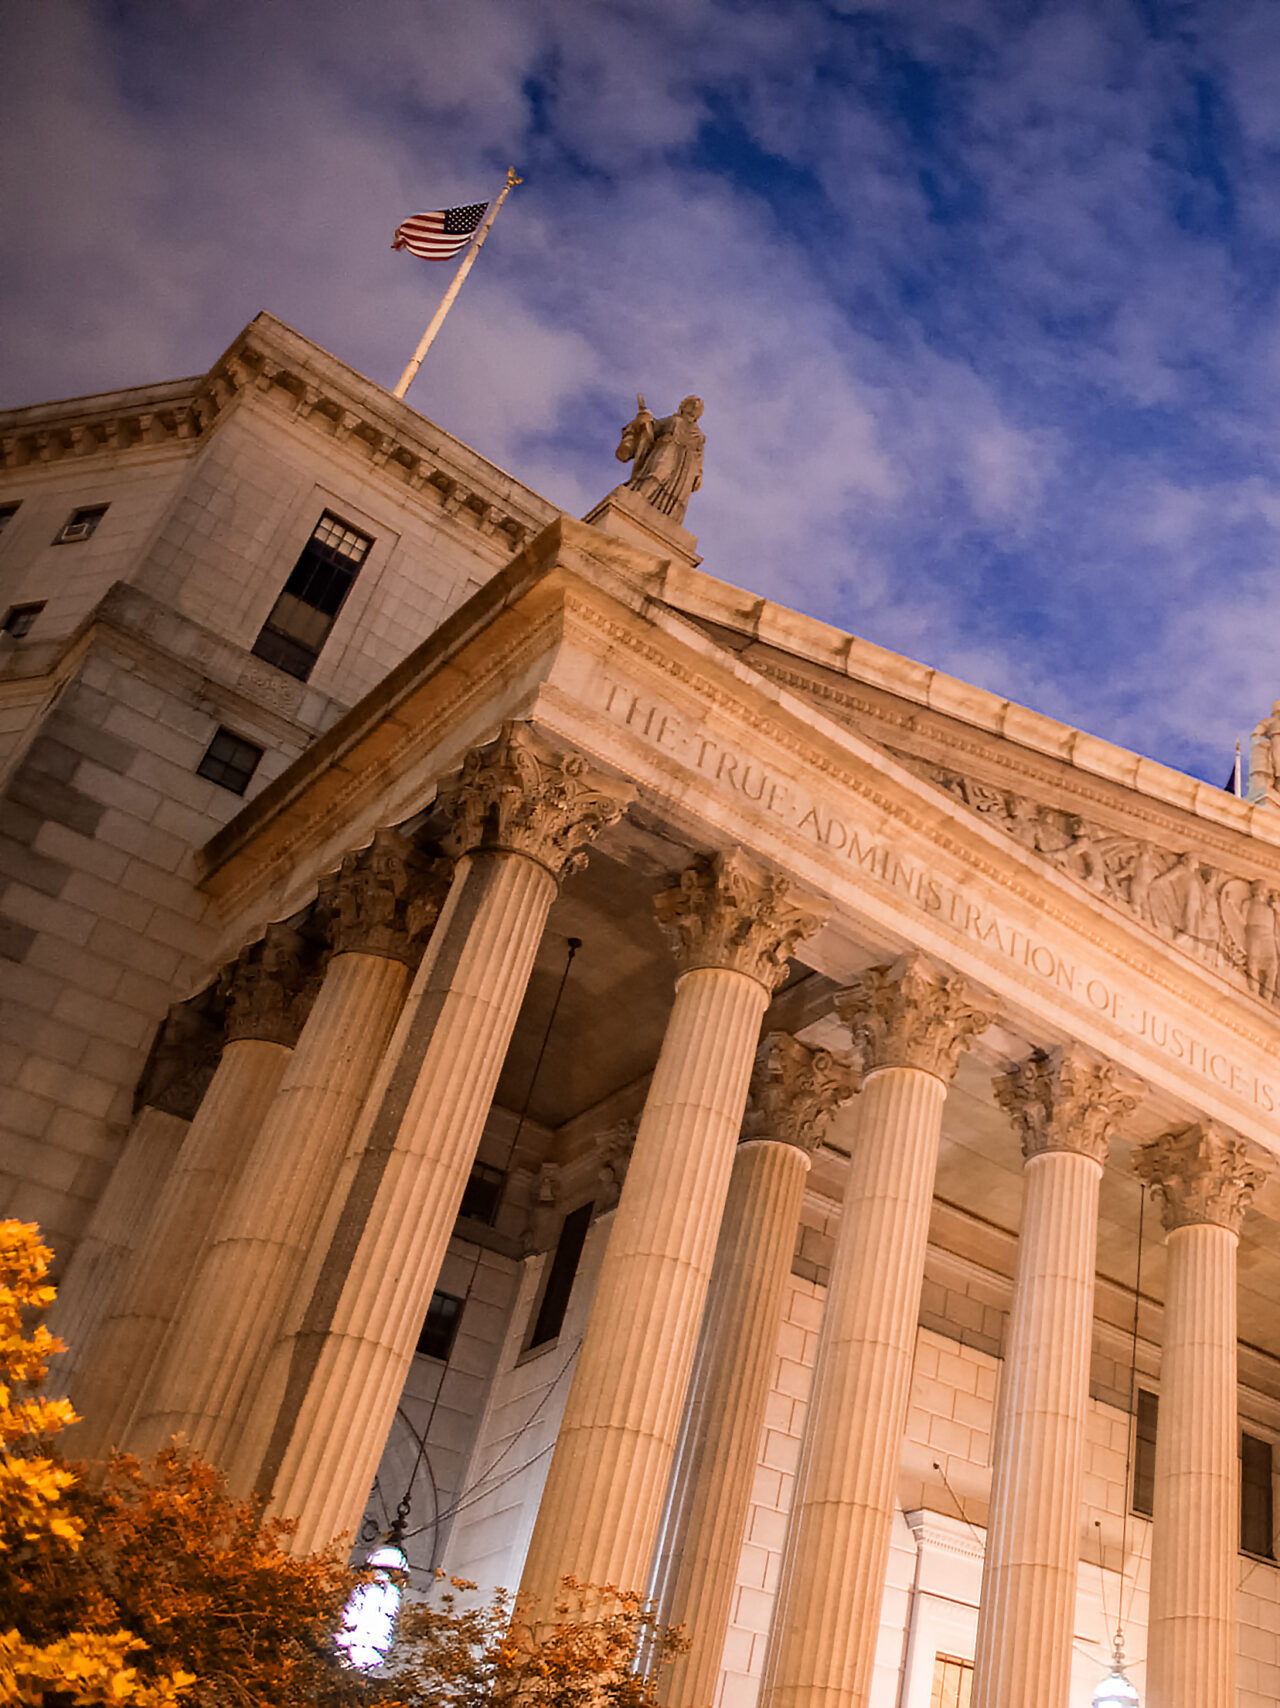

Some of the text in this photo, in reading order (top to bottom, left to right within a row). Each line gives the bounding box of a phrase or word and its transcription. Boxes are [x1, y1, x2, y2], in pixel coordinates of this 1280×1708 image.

[602, 676, 681, 751] THE
[694, 733, 789, 818] TRUE
[798, 806, 1078, 991] ADMINISTRATION
[1086, 979, 1125, 1019] OF
[1139, 1010, 1242, 1095] JUSTICE
[1253, 1078, 1274, 1113] IS
